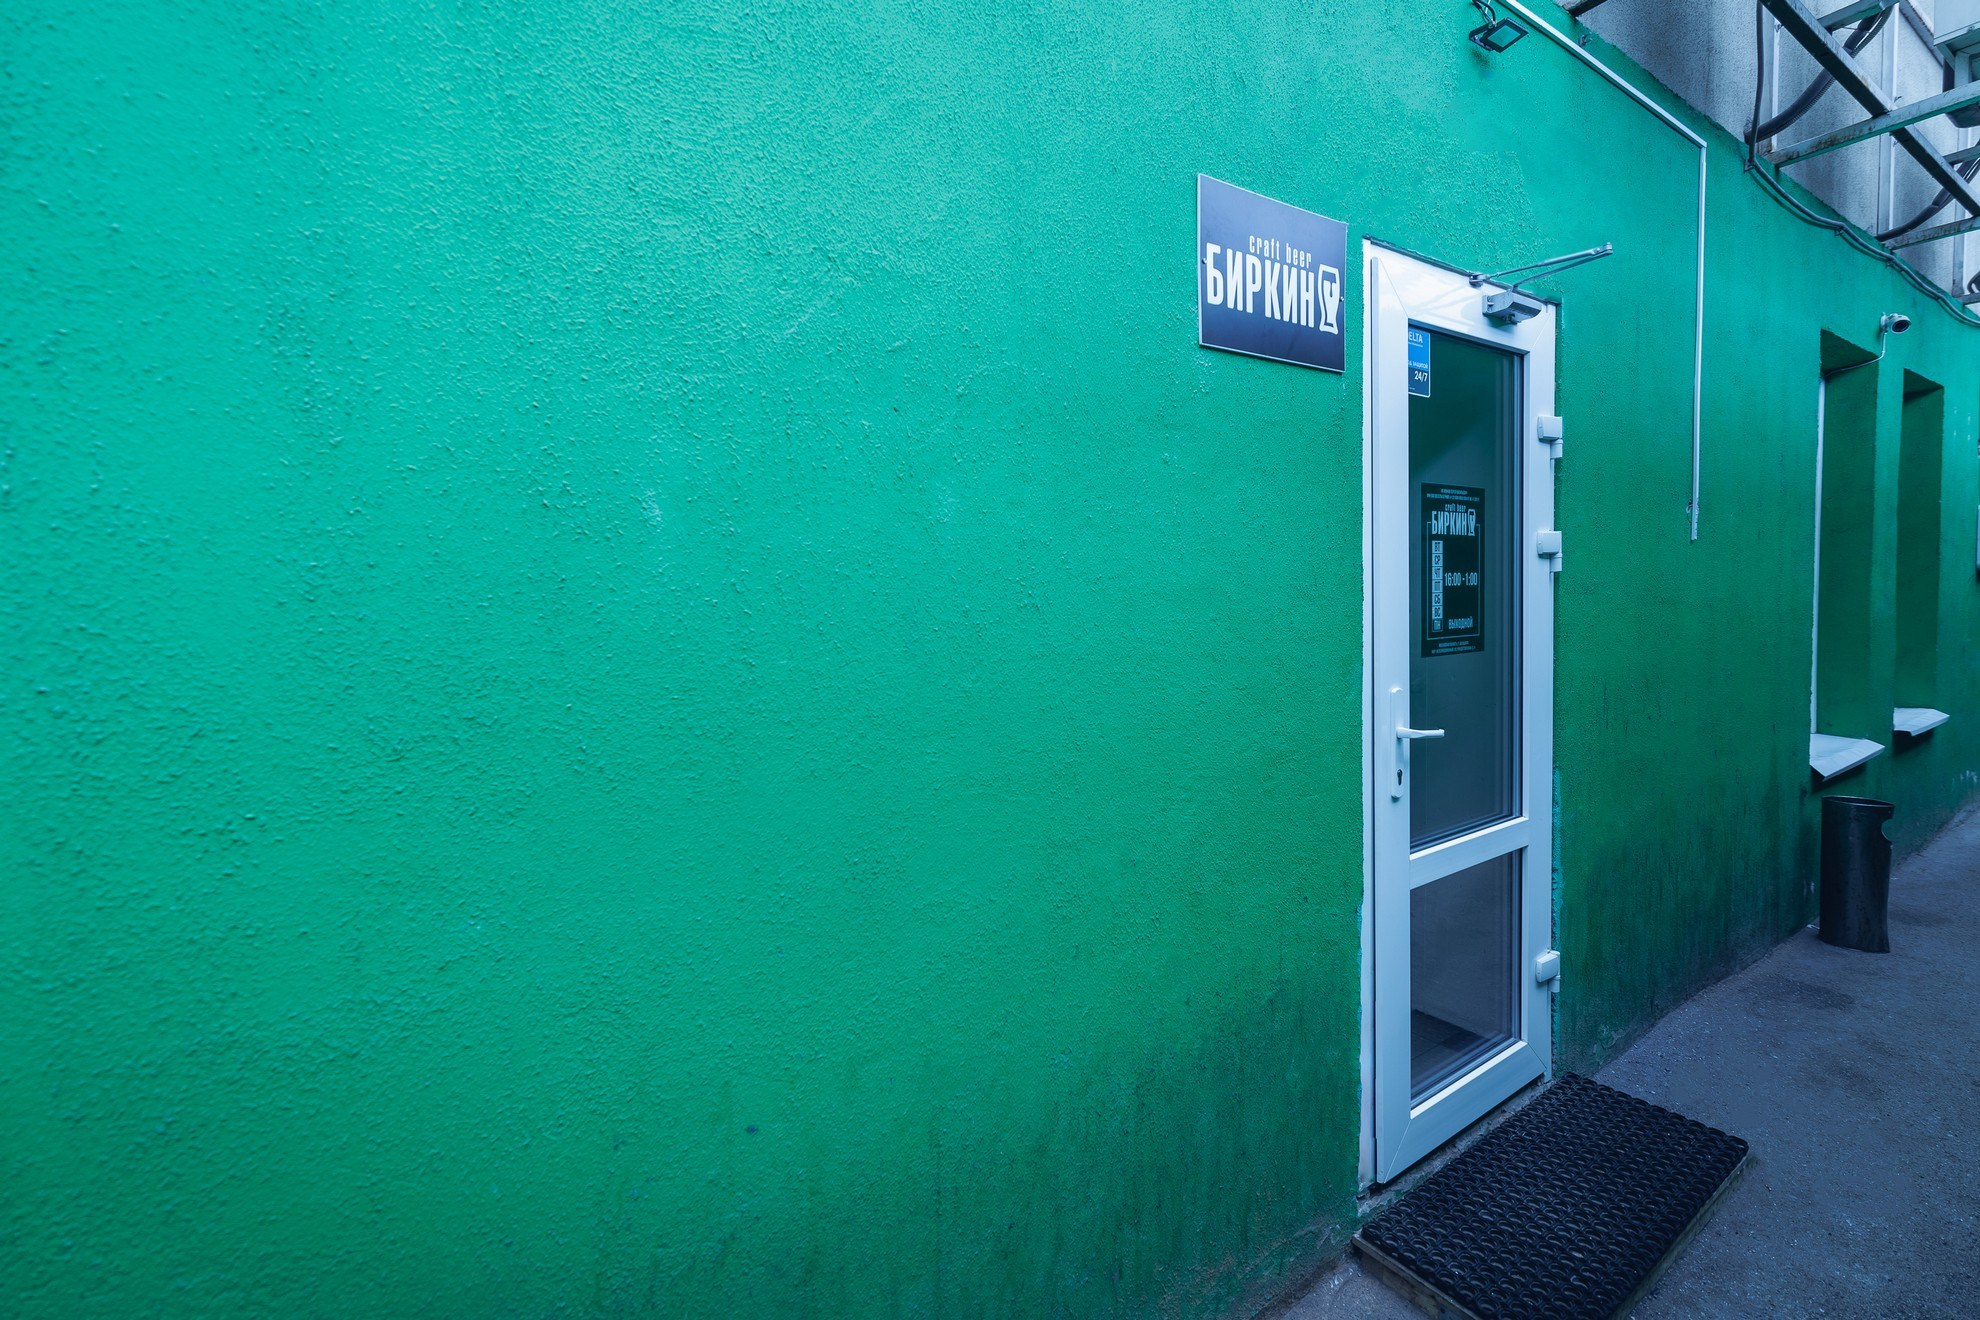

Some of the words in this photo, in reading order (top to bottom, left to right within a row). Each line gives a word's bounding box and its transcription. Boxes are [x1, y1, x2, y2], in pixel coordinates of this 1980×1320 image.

[1249, 235, 1280, 261] craft
[1285, 242, 1312, 269] beer
[1205, 242, 1315, 329] БИРКИН
[1408, 331, 1424, 344] ELTA
[1414, 370, 1428, 382] 24/7
[1456, 503, 1467, 512] beer
[1431, 510, 1467, 536] БИРКИН
[1444, 572, 1461, 586] 16:00
[1465, 572, 1478, 586] 1:00
